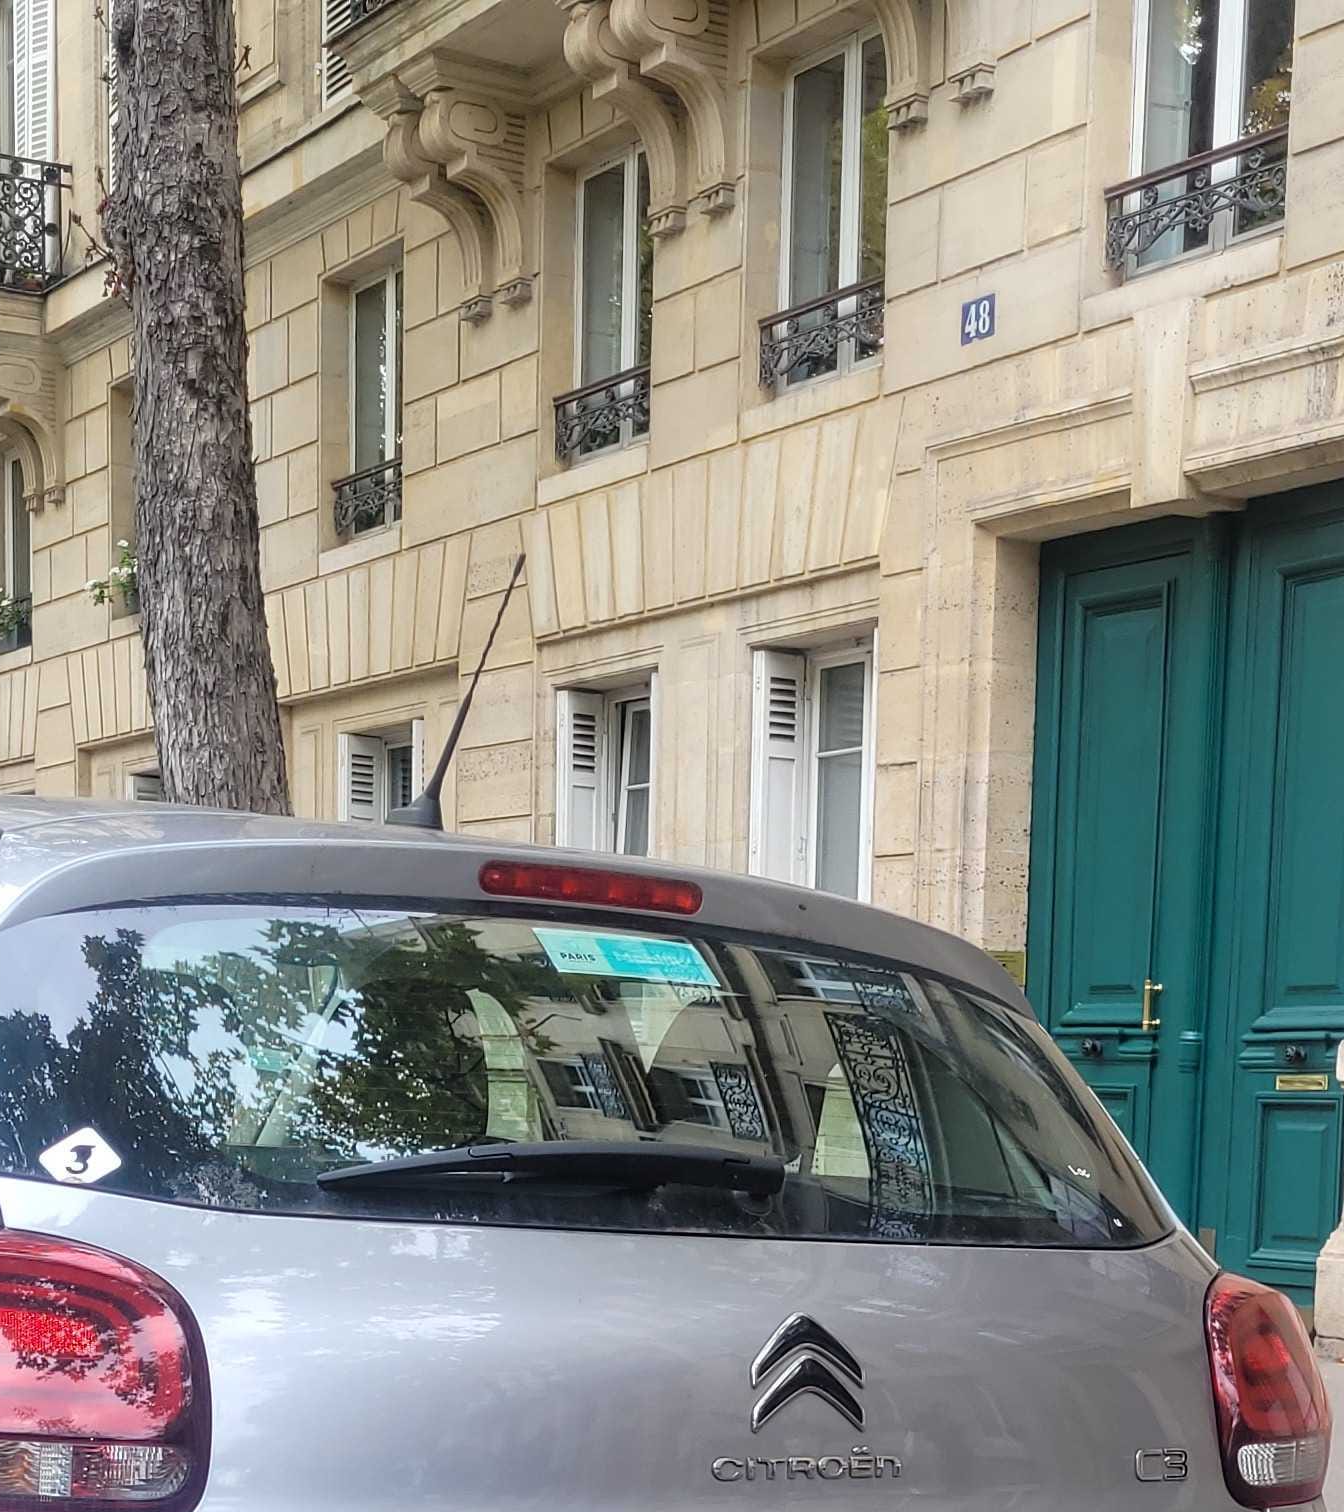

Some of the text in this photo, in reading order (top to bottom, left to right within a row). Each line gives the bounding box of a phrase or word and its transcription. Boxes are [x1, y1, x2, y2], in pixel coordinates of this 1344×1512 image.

[964, 300, 990, 337] 48
[559, 951, 597, 962] PARIS
[710, 1445, 903, 1483] CITROËN
[1134, 1448, 1189, 1483] C3
